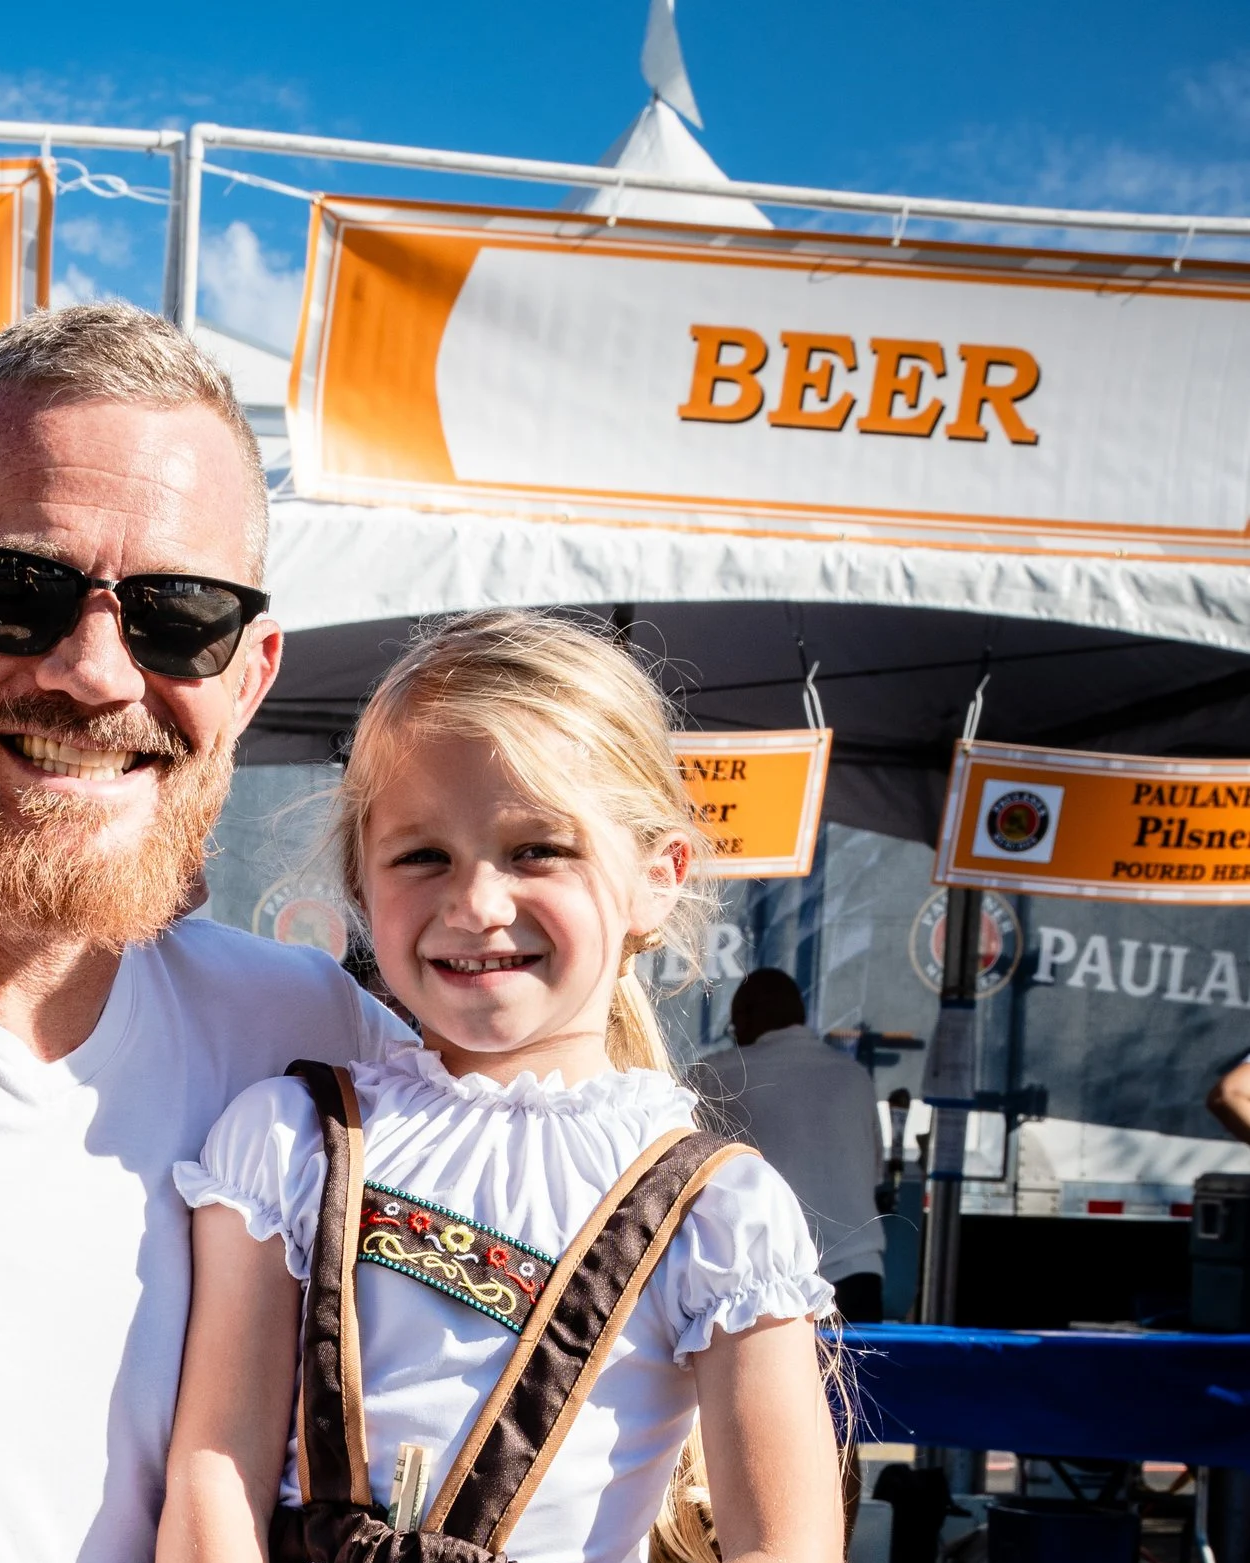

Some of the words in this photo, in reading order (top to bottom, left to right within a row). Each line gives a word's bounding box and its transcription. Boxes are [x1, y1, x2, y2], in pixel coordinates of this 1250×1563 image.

[677, 323, 1041, 446] BEER
[1134, 815, 1250, 851] Pilsne
[1111, 860, 1206, 881] POURED
[1033, 925, 1250, 1010] PAULA
